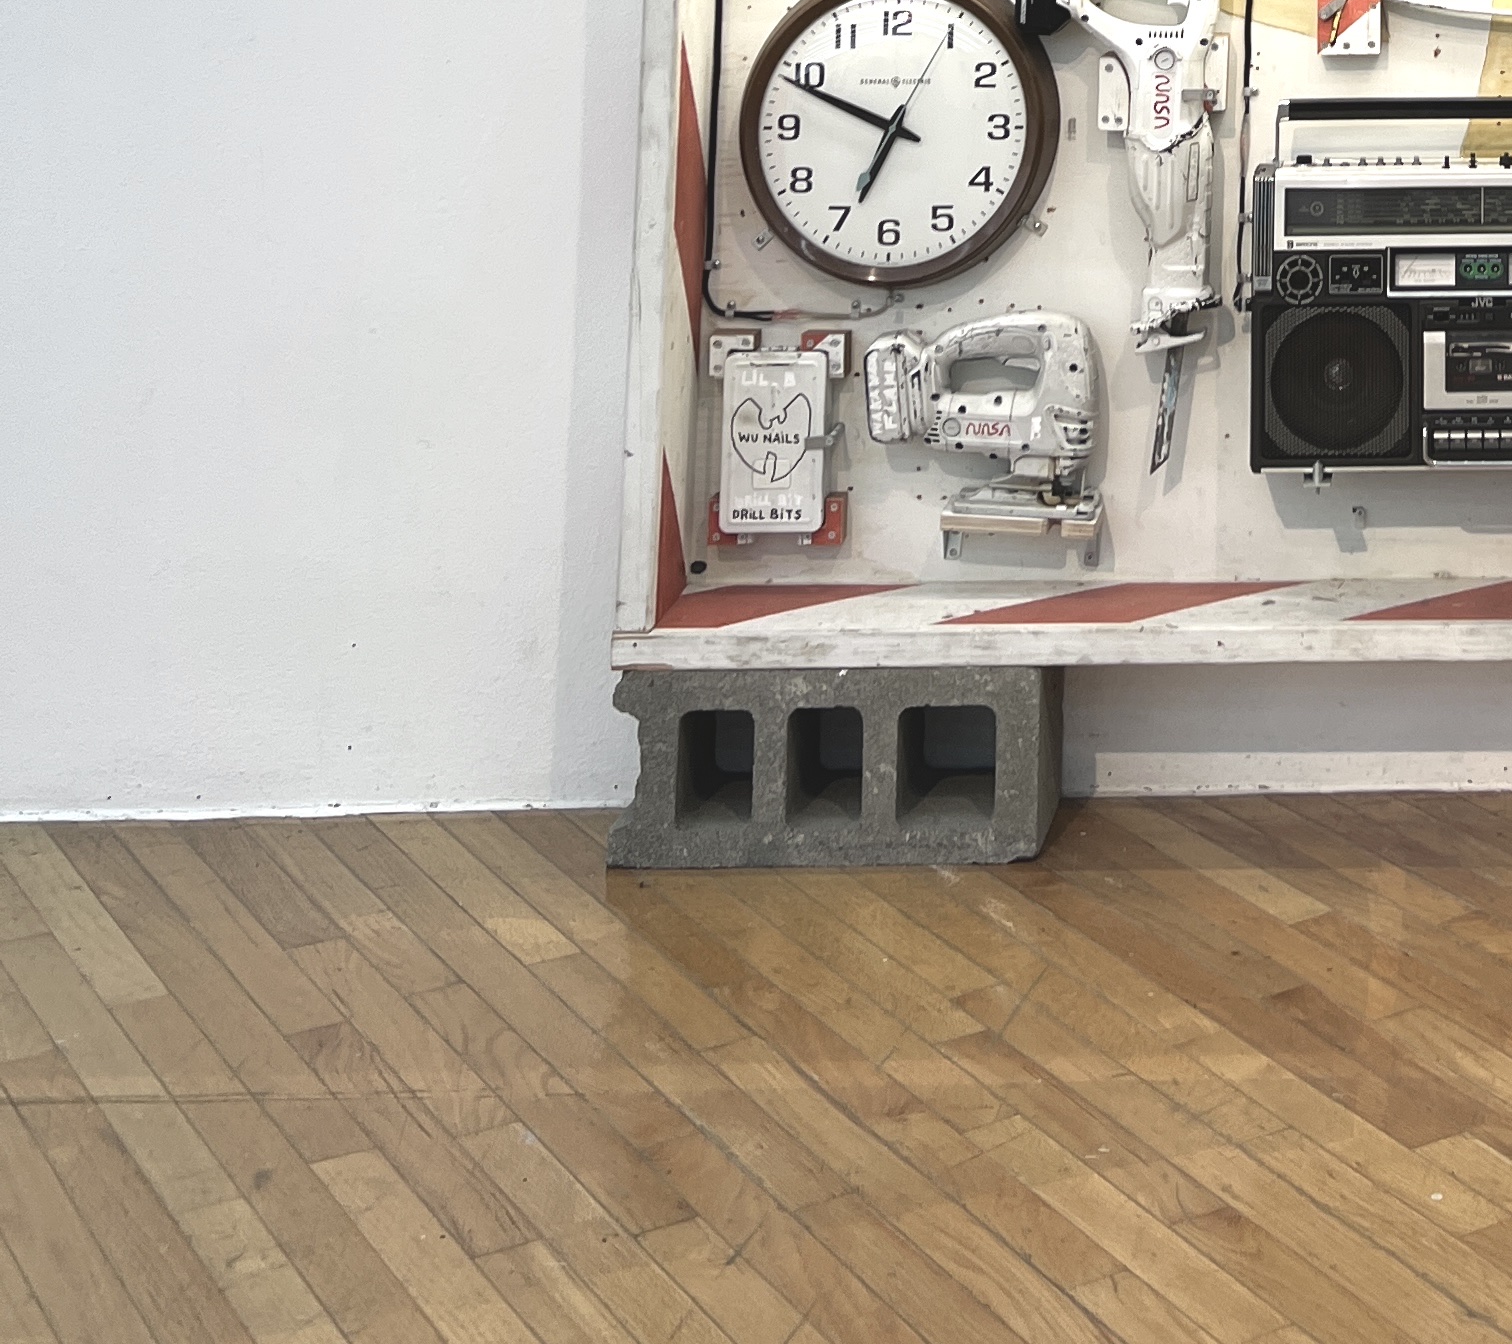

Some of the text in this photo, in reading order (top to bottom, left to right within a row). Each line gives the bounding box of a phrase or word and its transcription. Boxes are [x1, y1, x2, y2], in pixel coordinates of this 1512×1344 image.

[835, 23, 857, 49] 11
[883, 10, 912, 36] 12
[947, 23, 954, 49] 1
[794, 62, 825, 88] 10
[974, 62, 997, 88] 2
[777, 114, 801, 140] 9
[986, 114, 1011, 140] 3
[789, 166, 813, 193] 8
[967, 166, 994, 193] 4
[828, 205, 851, 232] 7
[931, 205, 954, 232] 5
[877, 219, 900, 246] 6
[1471, 296, 1493, 308] JVC
[737, 431, 800, 444] WU NAILS
[965, 421, 1012, 437] NASA
[732, 508, 803, 521] DRILL BITS
